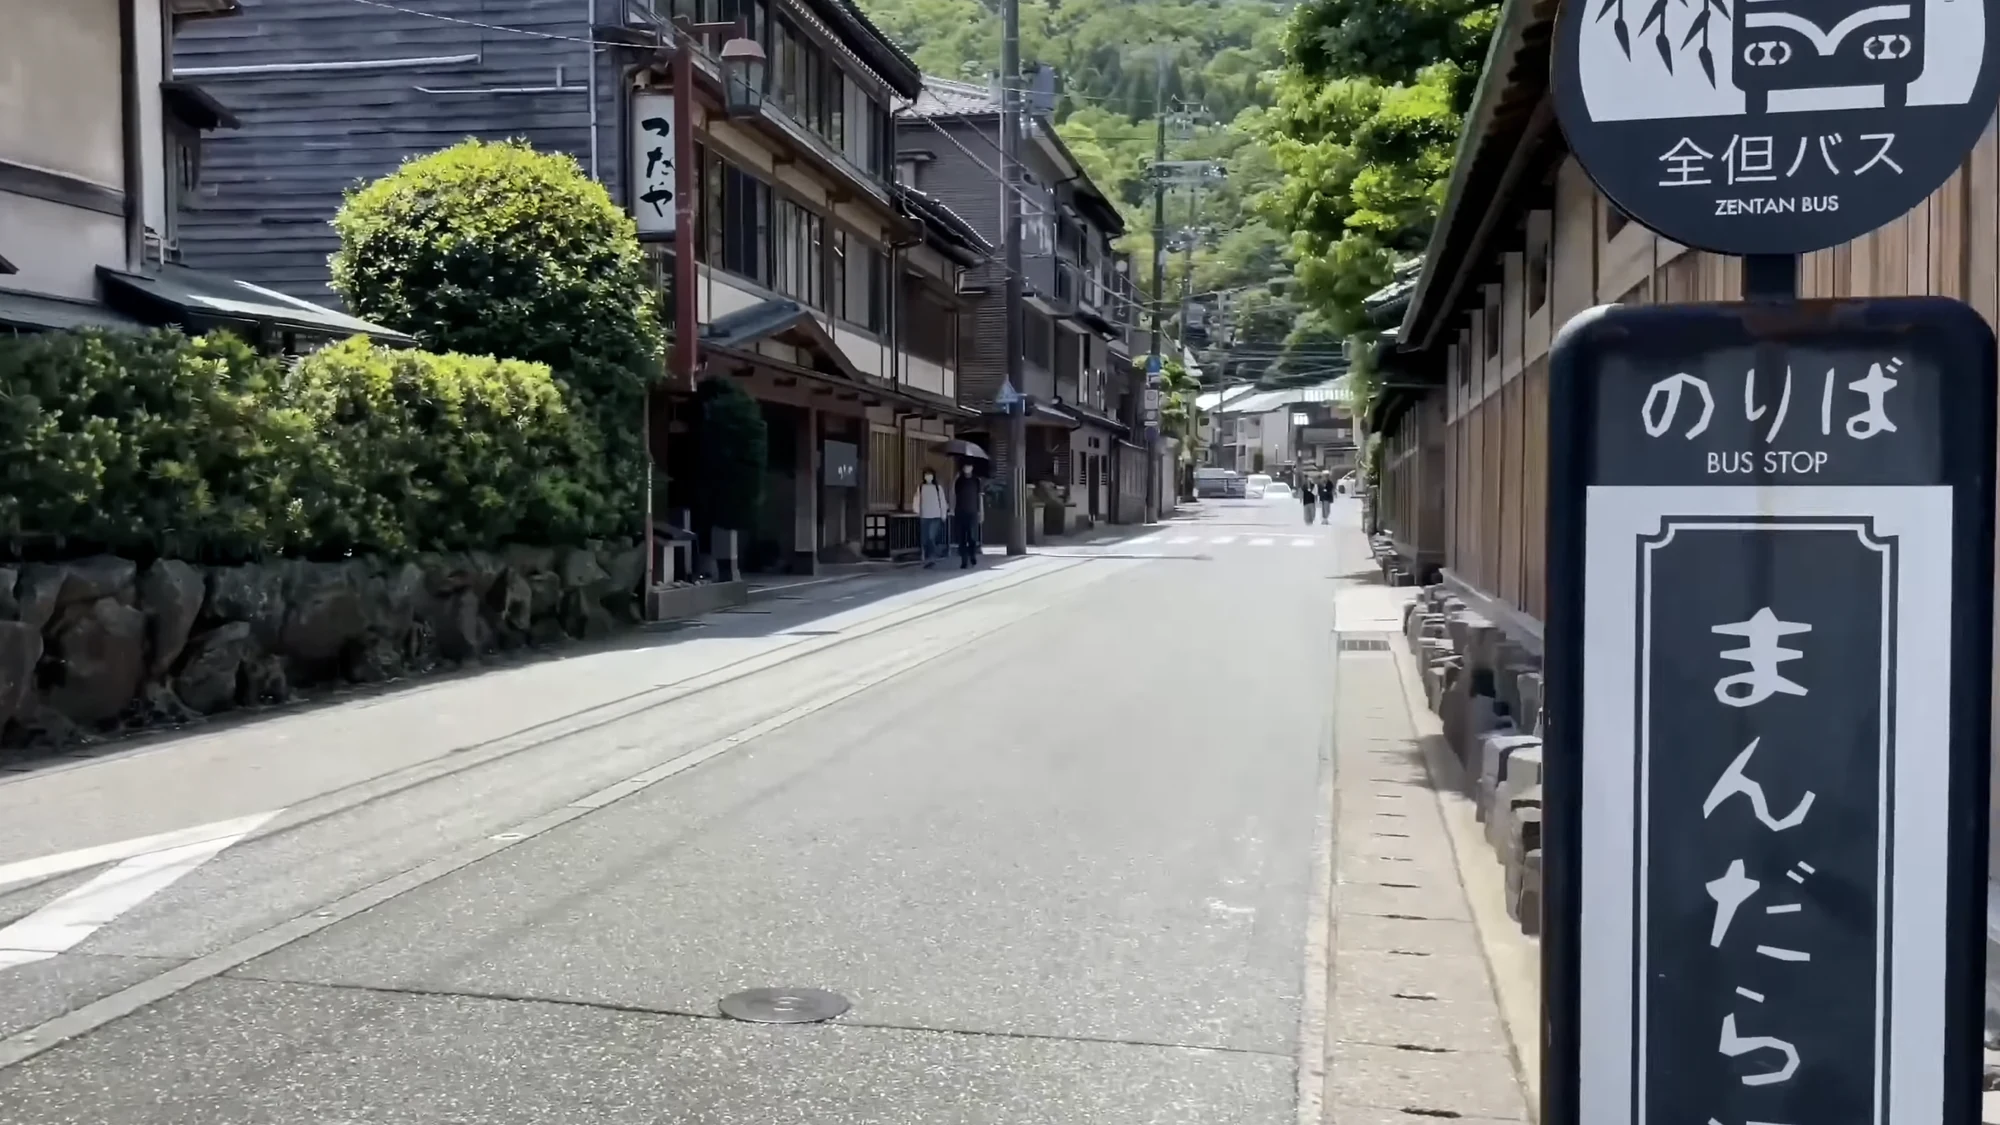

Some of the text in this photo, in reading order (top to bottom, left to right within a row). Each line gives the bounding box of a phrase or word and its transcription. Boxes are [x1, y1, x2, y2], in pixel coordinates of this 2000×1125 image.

[640, 117, 675, 218] つたや
[1658, 132, 1904, 187] 全但バス
[1715, 195, 1839, 216] ZENTAN BUS
[1641, 356, 1904, 444] のりば
[1707, 451, 1828, 474] BUS STOP
[1702, 606, 1816, 1125] まんだら
